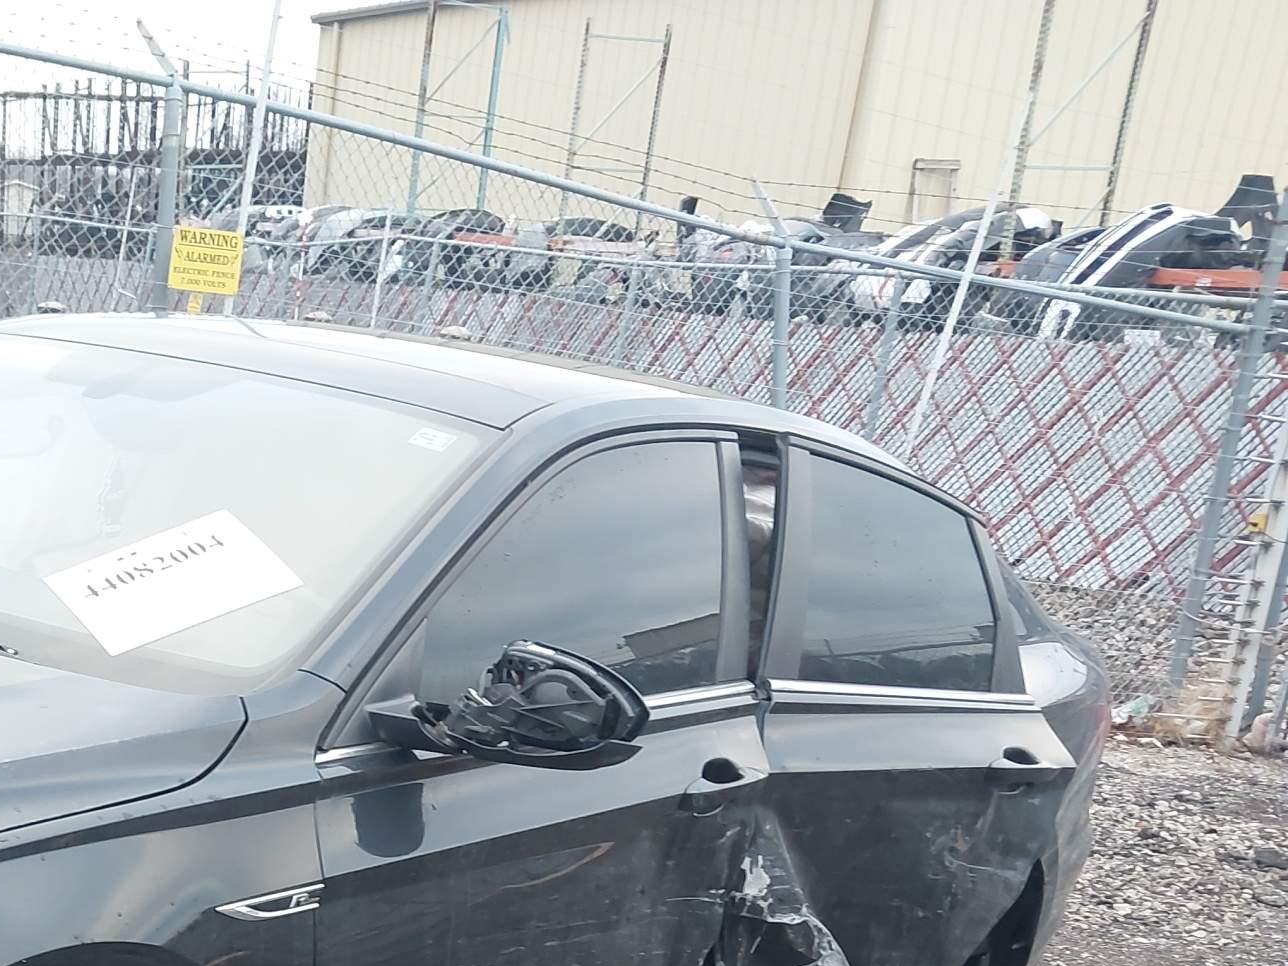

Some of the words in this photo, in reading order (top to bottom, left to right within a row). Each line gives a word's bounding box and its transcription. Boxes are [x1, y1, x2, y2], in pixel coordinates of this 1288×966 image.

[179, 229, 239, 249] WARNING
[183, 251, 230, 266] ALARMED
[173, 266, 210, 277] ELECTRIC
[211, 270, 237, 280] FENCE
[202, 279, 227, 289] VOLTS
[84, 534, 225, 598] 44082004
